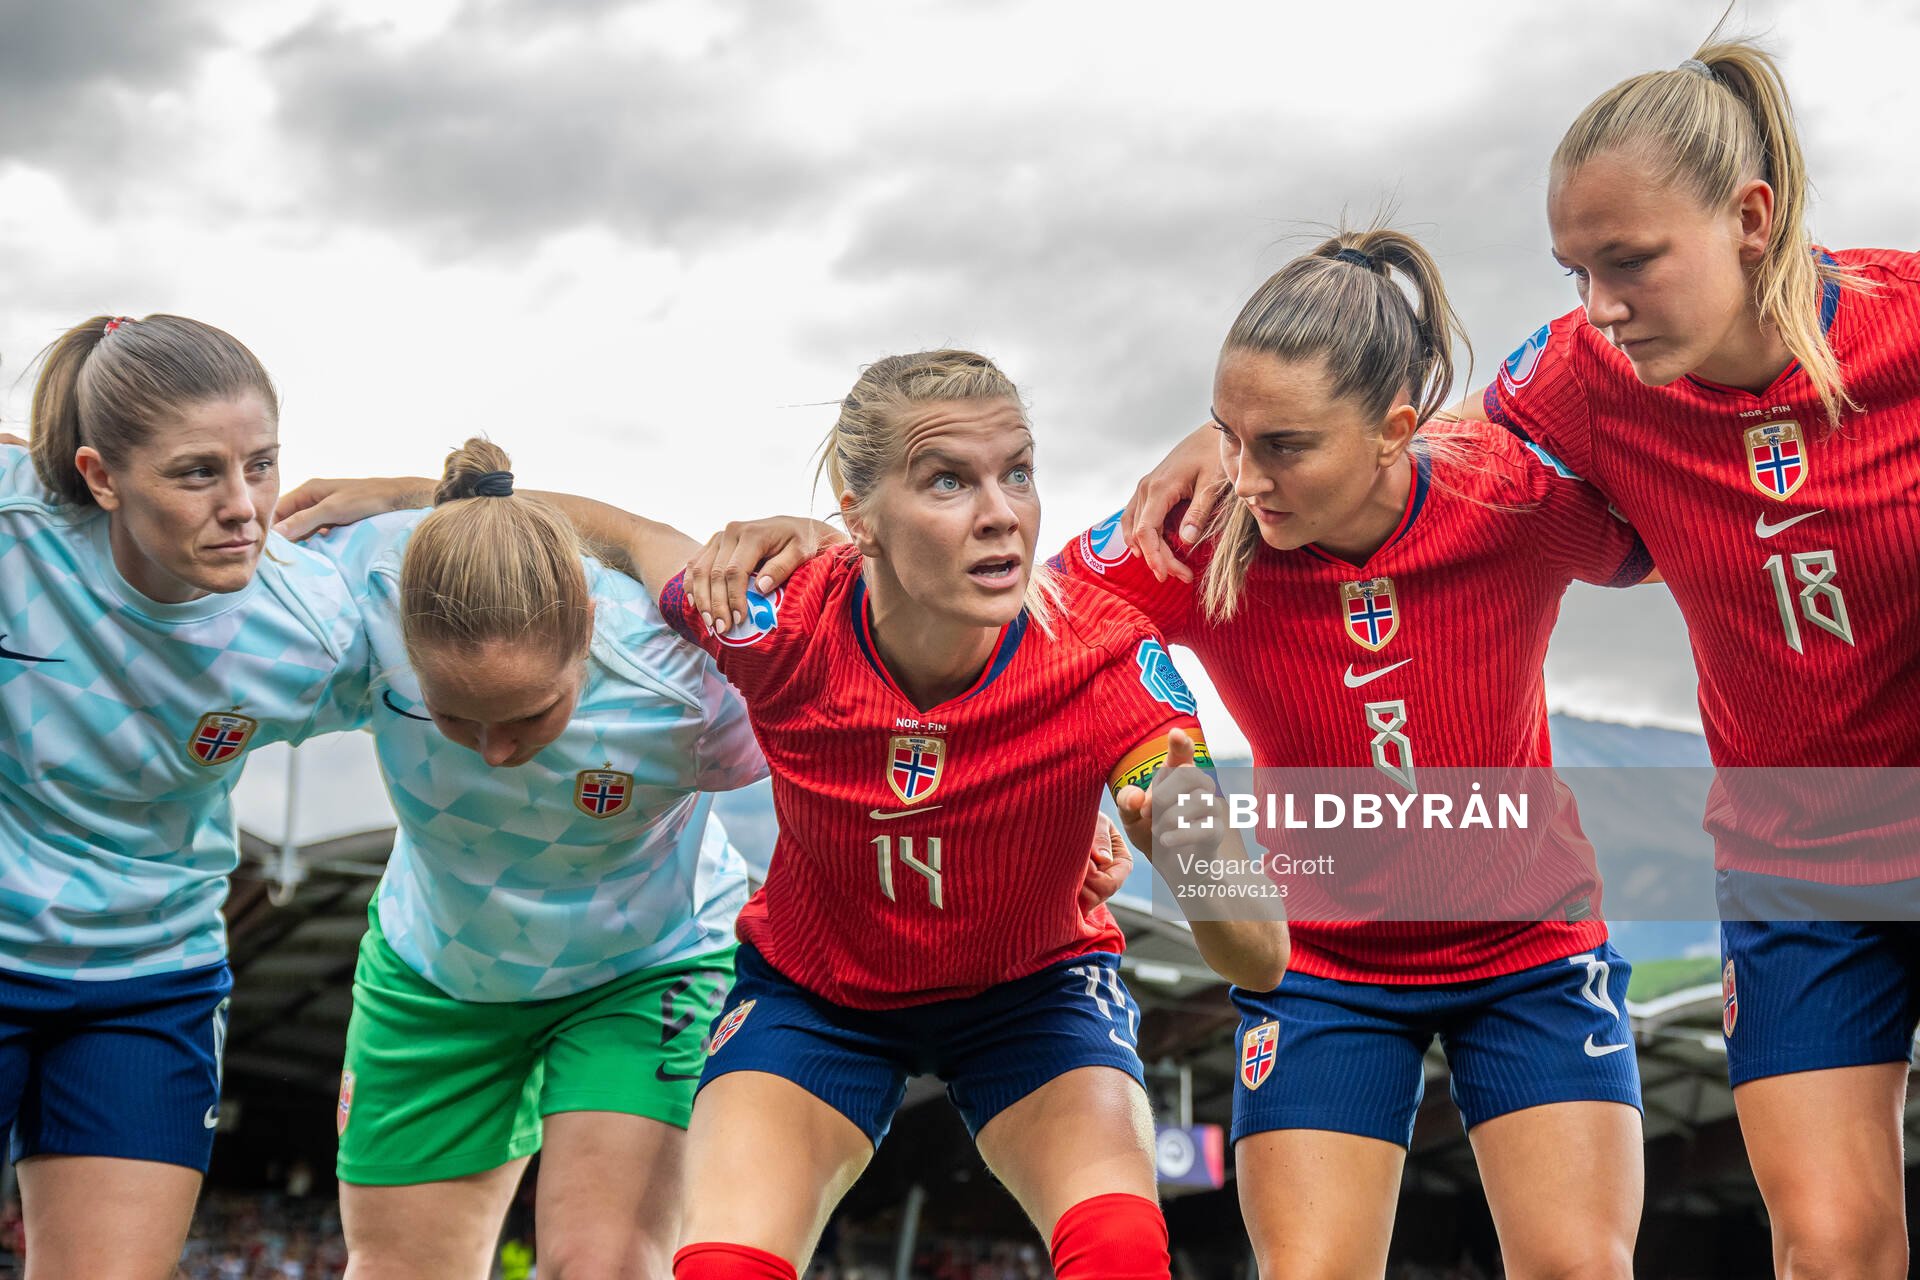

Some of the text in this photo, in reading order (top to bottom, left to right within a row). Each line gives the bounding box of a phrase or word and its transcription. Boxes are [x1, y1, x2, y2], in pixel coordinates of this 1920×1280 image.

[1739, 410, 1762, 418] NOR
[1771, 404, 1791, 414] FIN
[1089, 558, 1103, 571] 2025
[1762, 550, 1855, 655] 18
[896, 717, 919, 729] NOR
[928, 722, 947, 731] FIN
[1364, 699, 1418, 794] 8
[870, 834, 943, 910] 14
